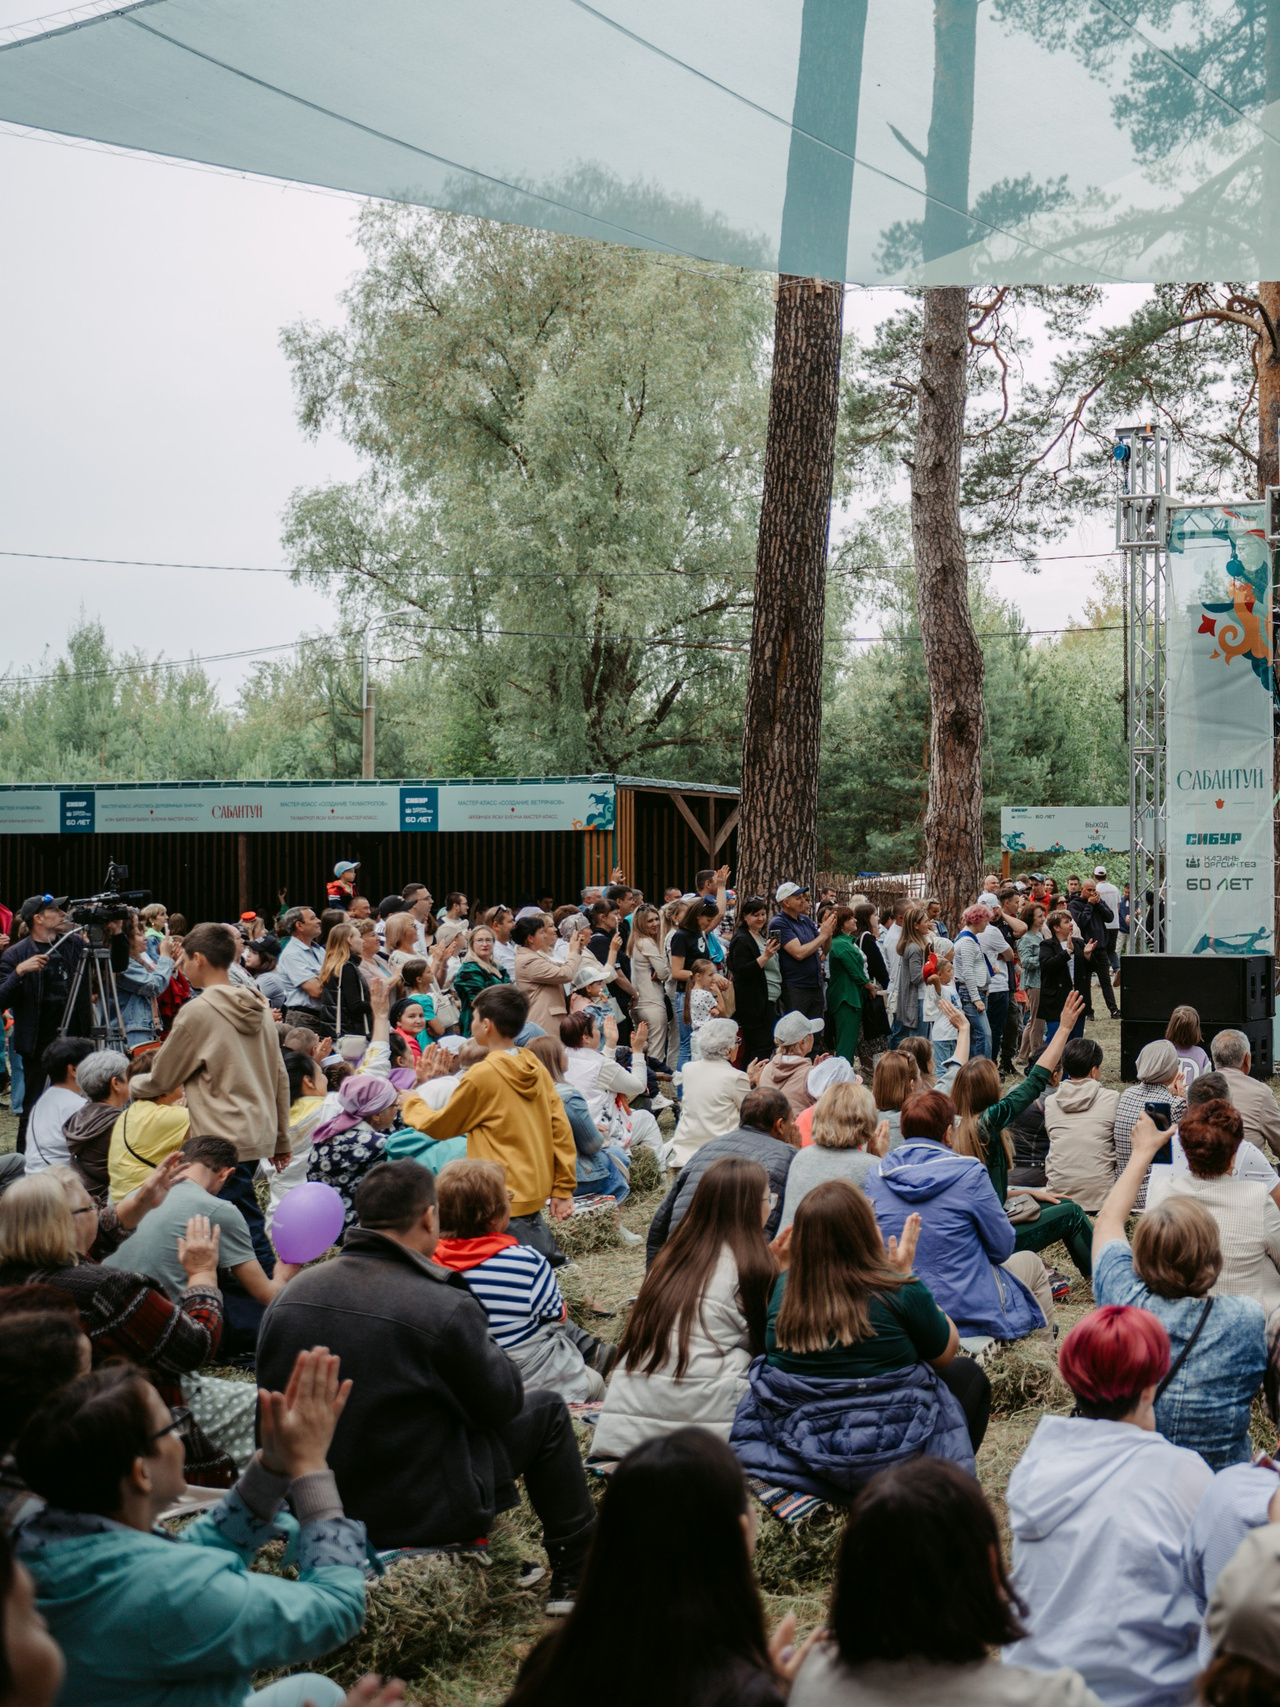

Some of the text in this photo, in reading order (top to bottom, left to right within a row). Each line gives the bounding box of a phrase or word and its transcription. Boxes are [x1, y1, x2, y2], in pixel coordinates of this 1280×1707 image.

[1176, 766, 1264, 790] САБАНТУЙ
[211, 804, 263, 819] САБАНТУЙ
[1186, 832, 1242, 845] СИБУР
[1204, 861, 1257, 869] ОРГСИНТЕЗ
[1186, 878, 1254, 891] 60 ЛЕТ
